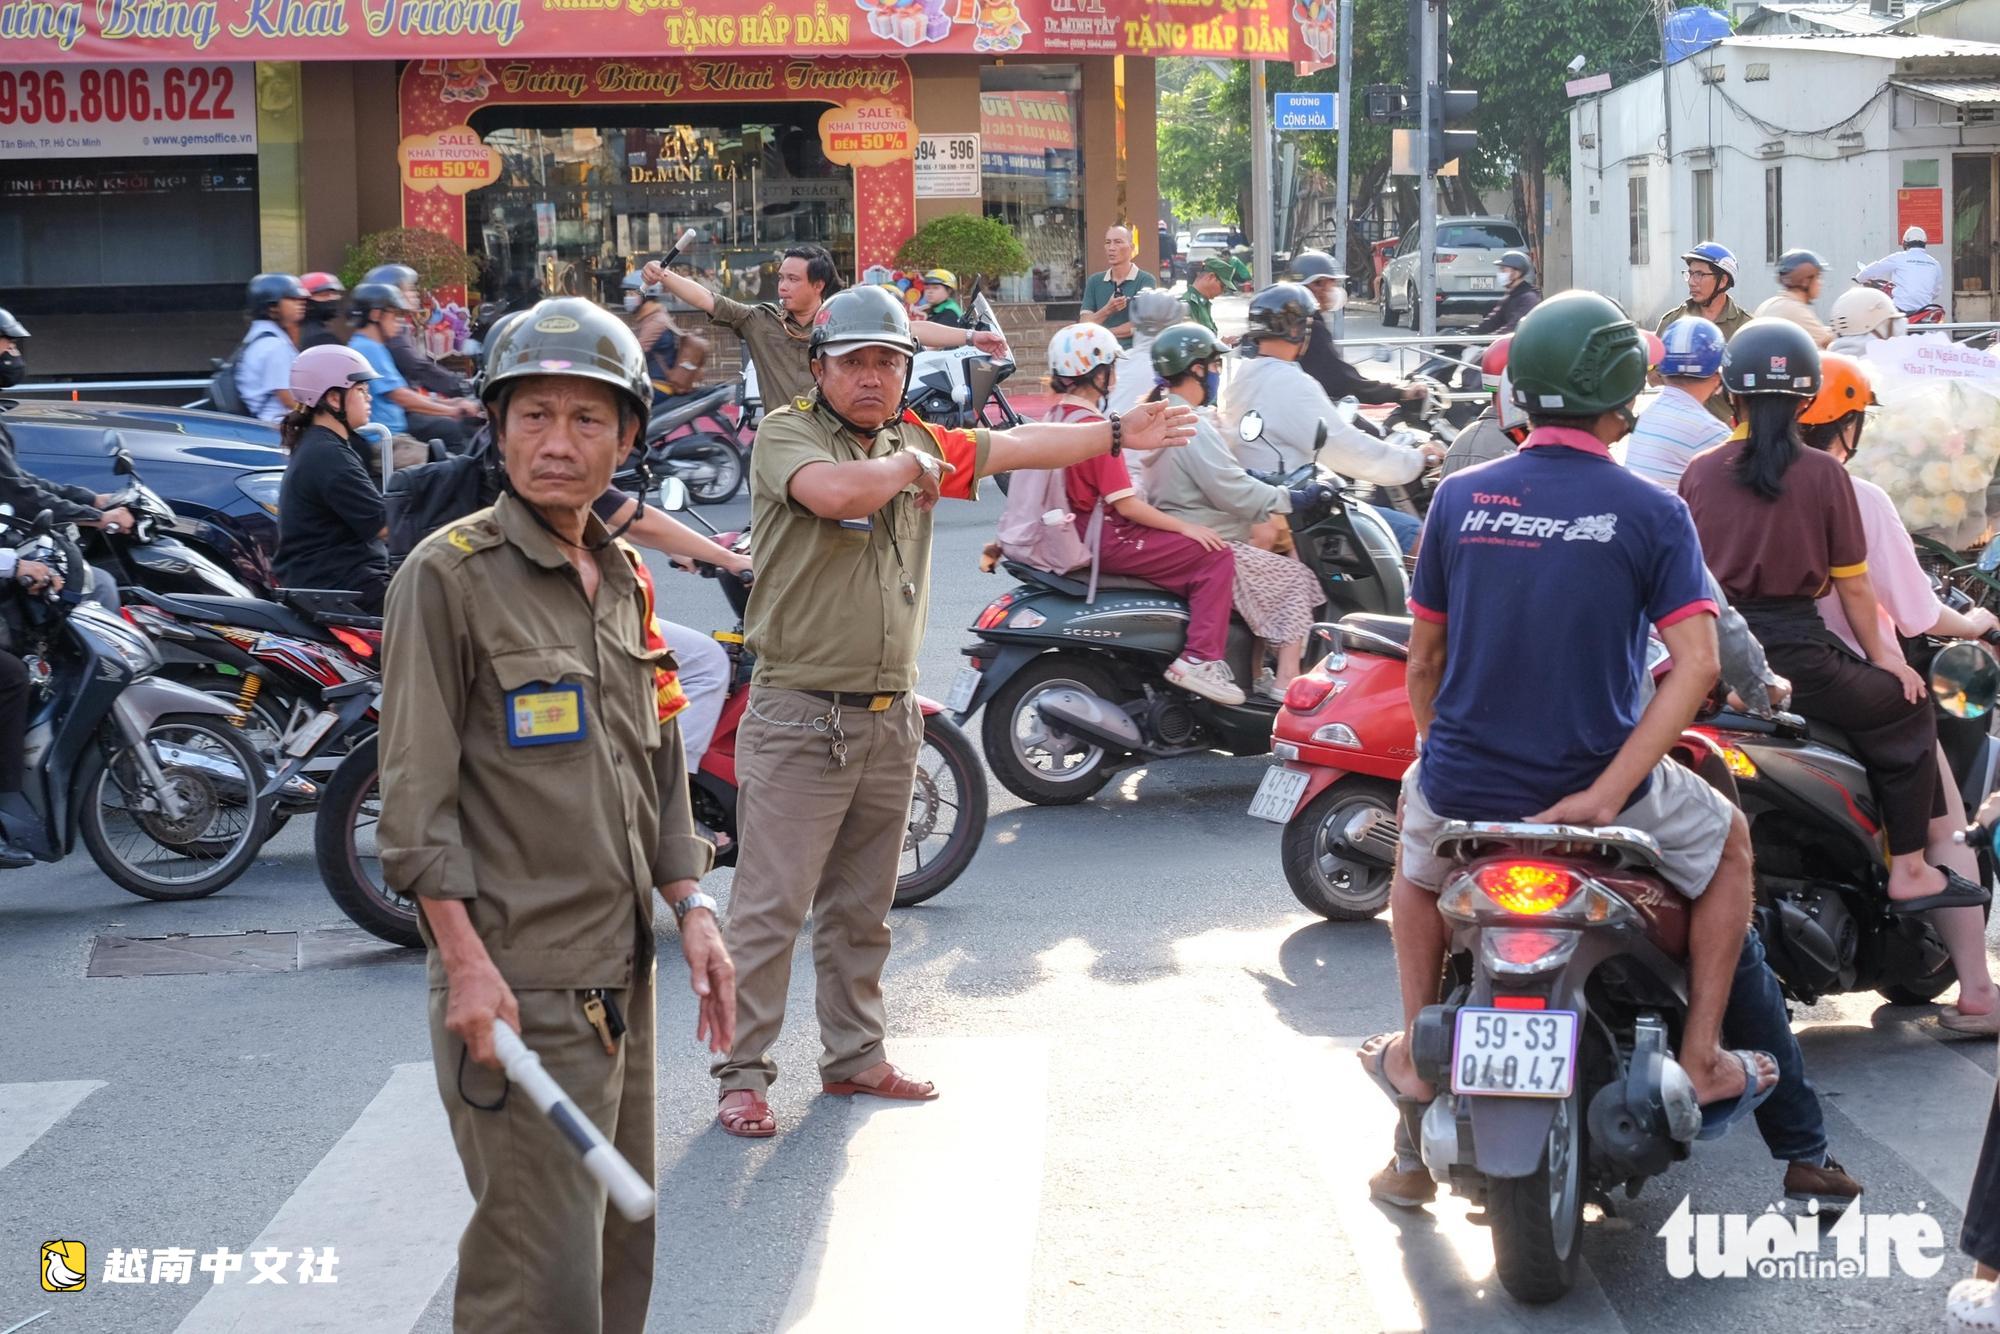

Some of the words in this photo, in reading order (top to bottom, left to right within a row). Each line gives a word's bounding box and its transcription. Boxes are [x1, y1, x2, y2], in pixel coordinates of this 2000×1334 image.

[664, 7, 735, 53] TẶNG
[738, 3, 791, 45] HẤP
[795, 2, 849, 45] DẪN
[1124, 15, 1187, 54] TẶNG
[1191, 15, 1238, 50] HẤP
[1242, 15, 1289, 53] DẪN
[690, 62, 774, 90] Khai
[857, 107, 892, 119] SALE
[1283, 111, 1307, 127] CỘNG
[1308, 111, 1327, 126] HÒA
[828, 122, 855, 131] KHAI
[438, 135, 475, 145] SALE
[408, 148, 435, 158] KHAI
[950, 140, 974, 160] 596
[1472, 492, 1522, 507] TOTAL
[1460, 509, 1570, 538] HI-PERF
[1063, 628, 1122, 638] SCOOPY
[1475, 1016, 1557, 1050] 59-S3
